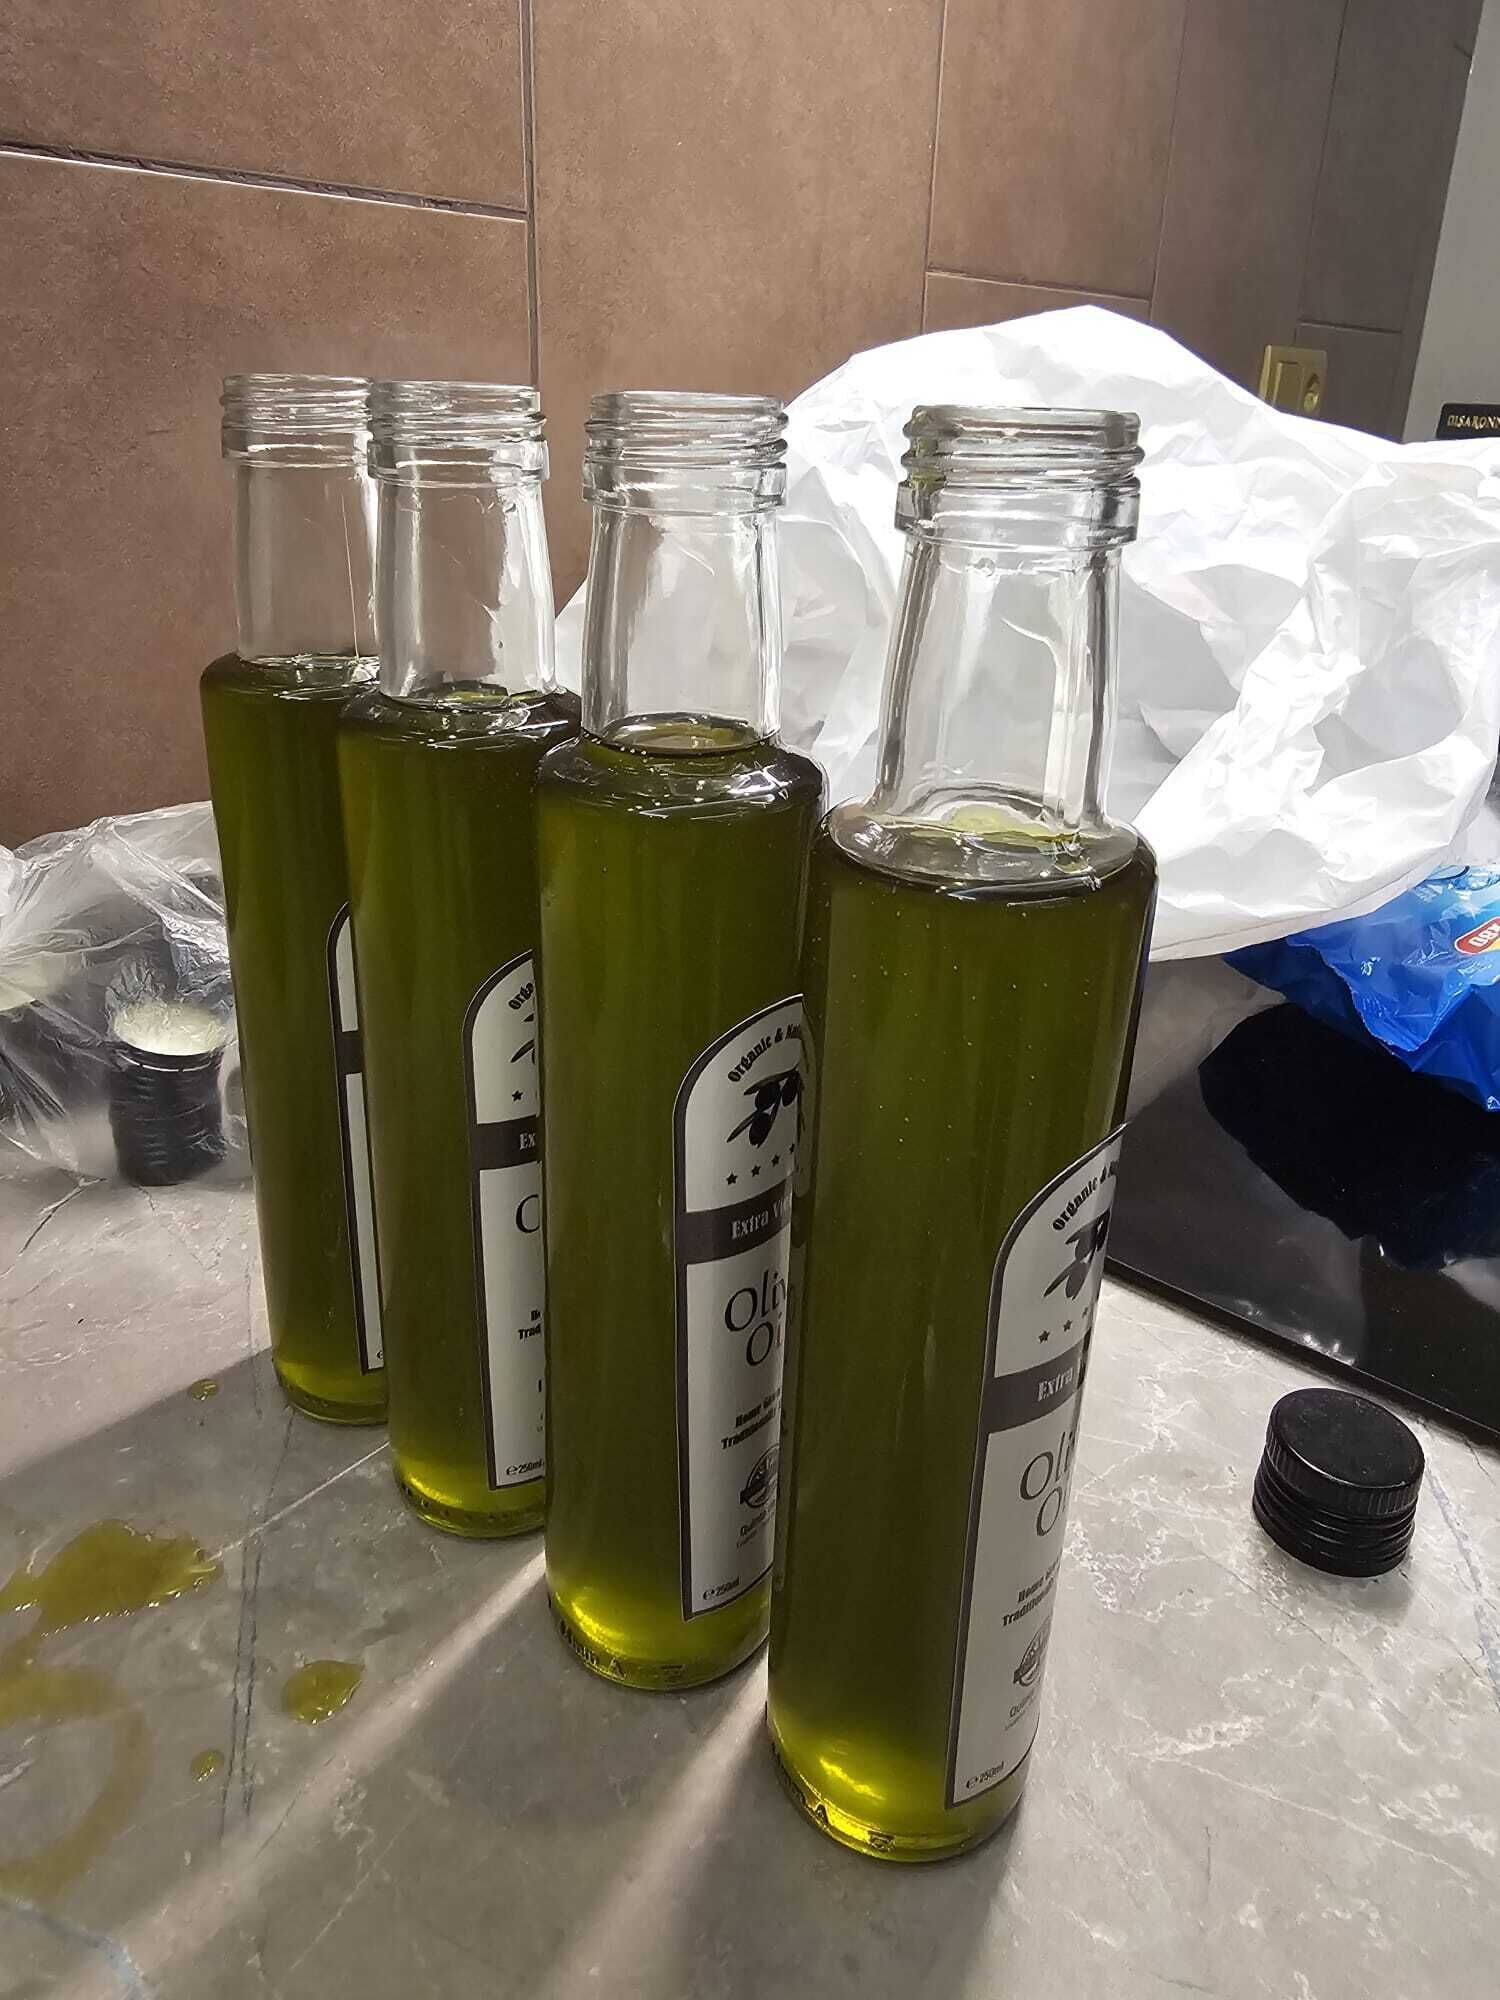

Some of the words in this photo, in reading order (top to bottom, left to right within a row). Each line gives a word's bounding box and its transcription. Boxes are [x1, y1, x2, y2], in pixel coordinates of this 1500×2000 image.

[728, 1036, 773, 1082] Organic
[1052, 1176, 1098, 1231] Organic
[731, 1211, 769, 1240] Extra
[1037, 1367, 1074, 1402] Extra
